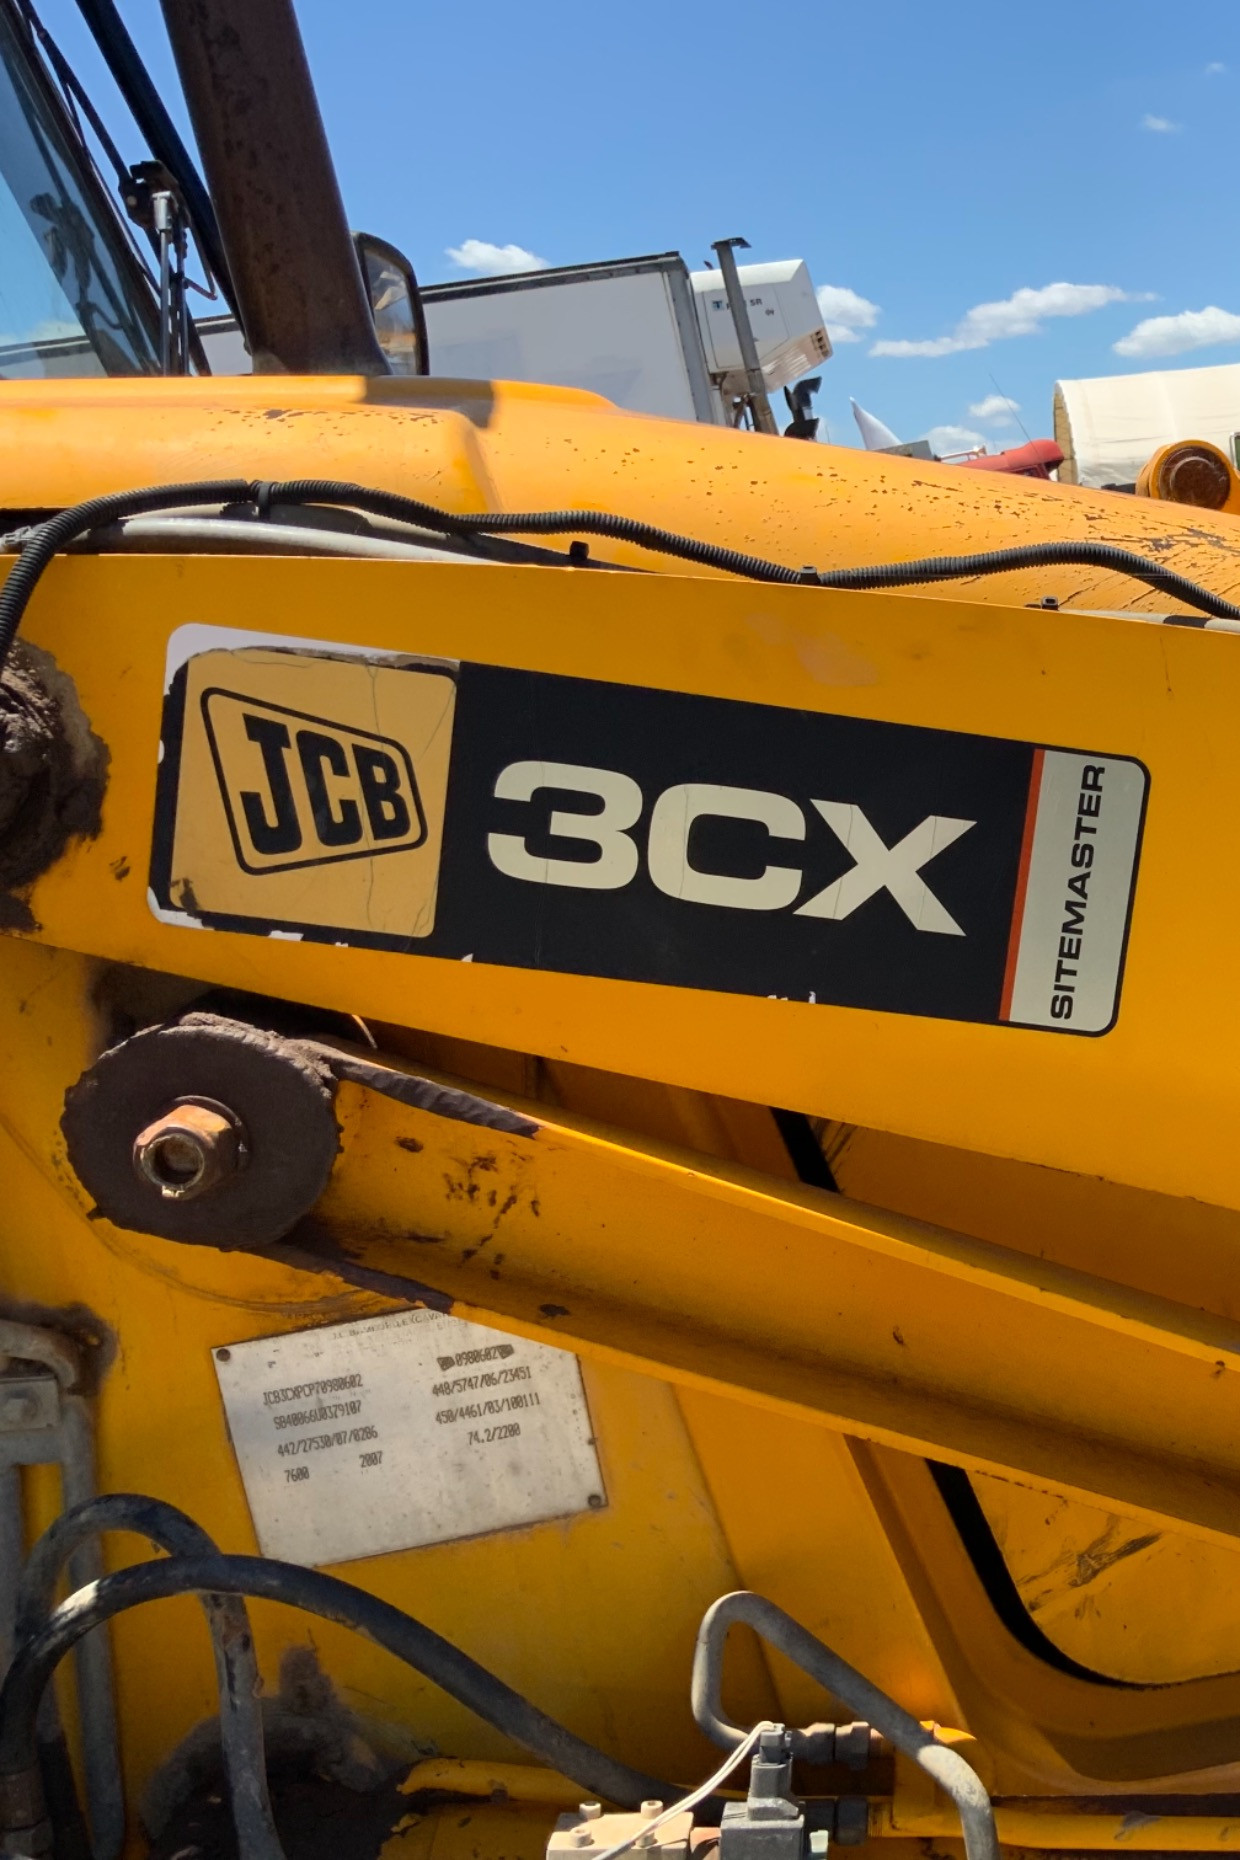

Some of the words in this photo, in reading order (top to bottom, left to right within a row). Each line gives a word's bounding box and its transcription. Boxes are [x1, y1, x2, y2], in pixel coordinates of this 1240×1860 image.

[239, 712, 411, 855] JCB
[487, 760, 978, 937] 3CX
[1050, 764, 1106, 1020] SITEMASTER
[284, 1466, 310, 1483] 7600
[359, 1450, 383, 1468] 2007
[467, 1422, 521, 1445] 74.2/2200
